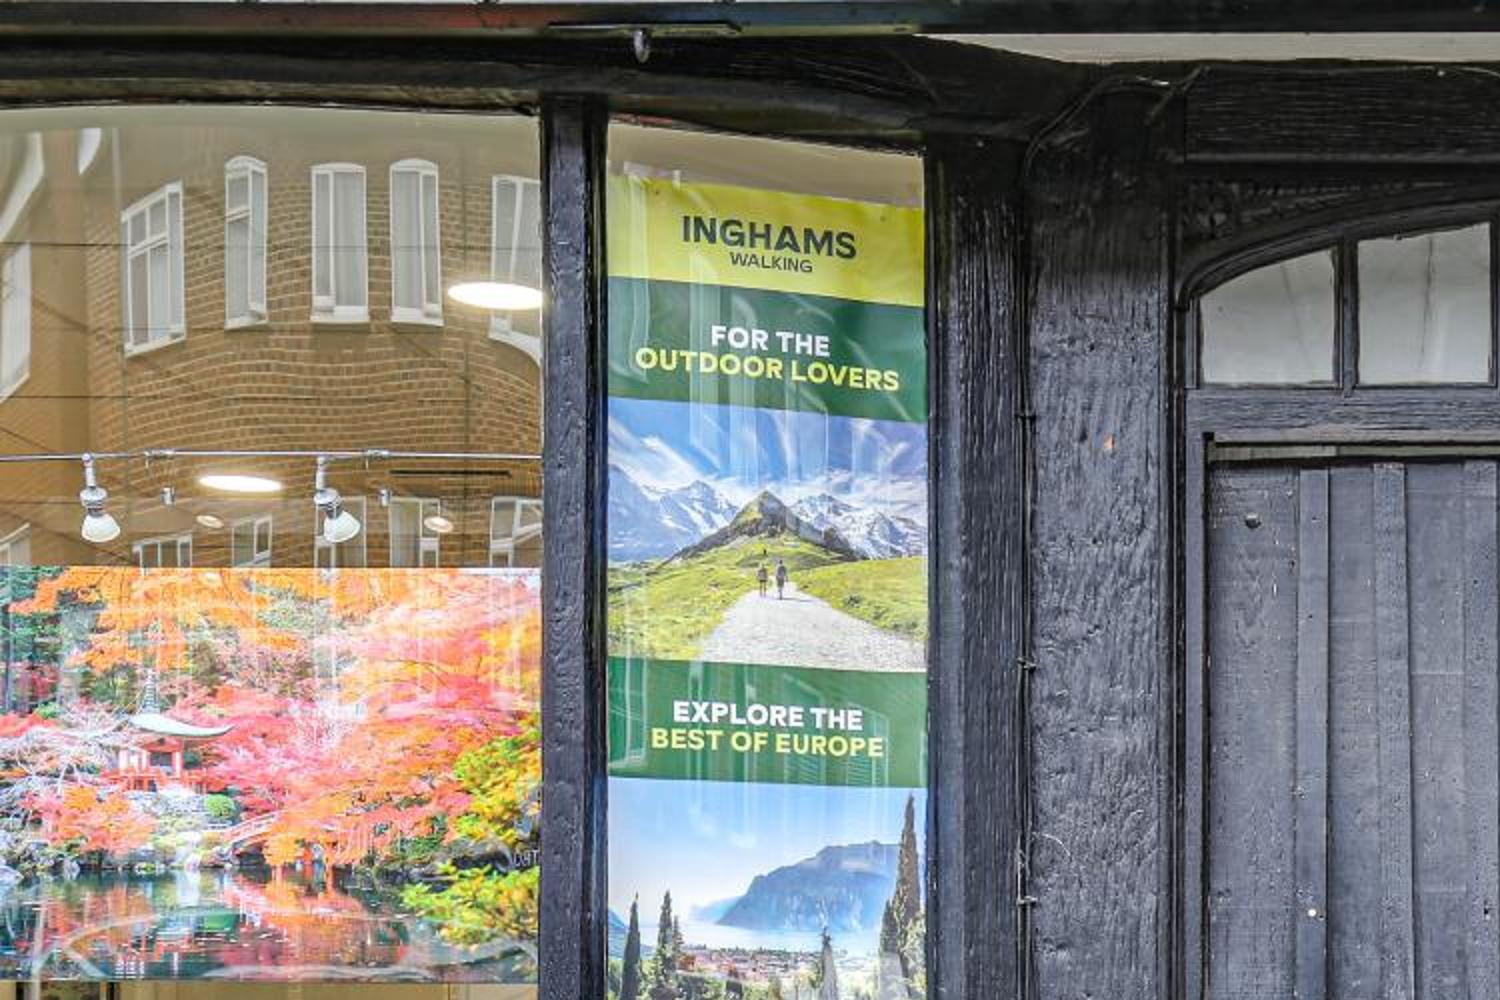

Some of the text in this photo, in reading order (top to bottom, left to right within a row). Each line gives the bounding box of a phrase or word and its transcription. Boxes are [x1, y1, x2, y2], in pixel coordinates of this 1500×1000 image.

[682, 215, 857, 260] INGHAMS
[729, 251, 813, 273] WALKING
[711, 325, 830, 357] FOR THE
[635, 347, 900, 392] OUTDOOR LOVERS
[672, 700, 863, 731] EXPLORE THE
[651, 728, 884, 758] BEST OF EUROPE
